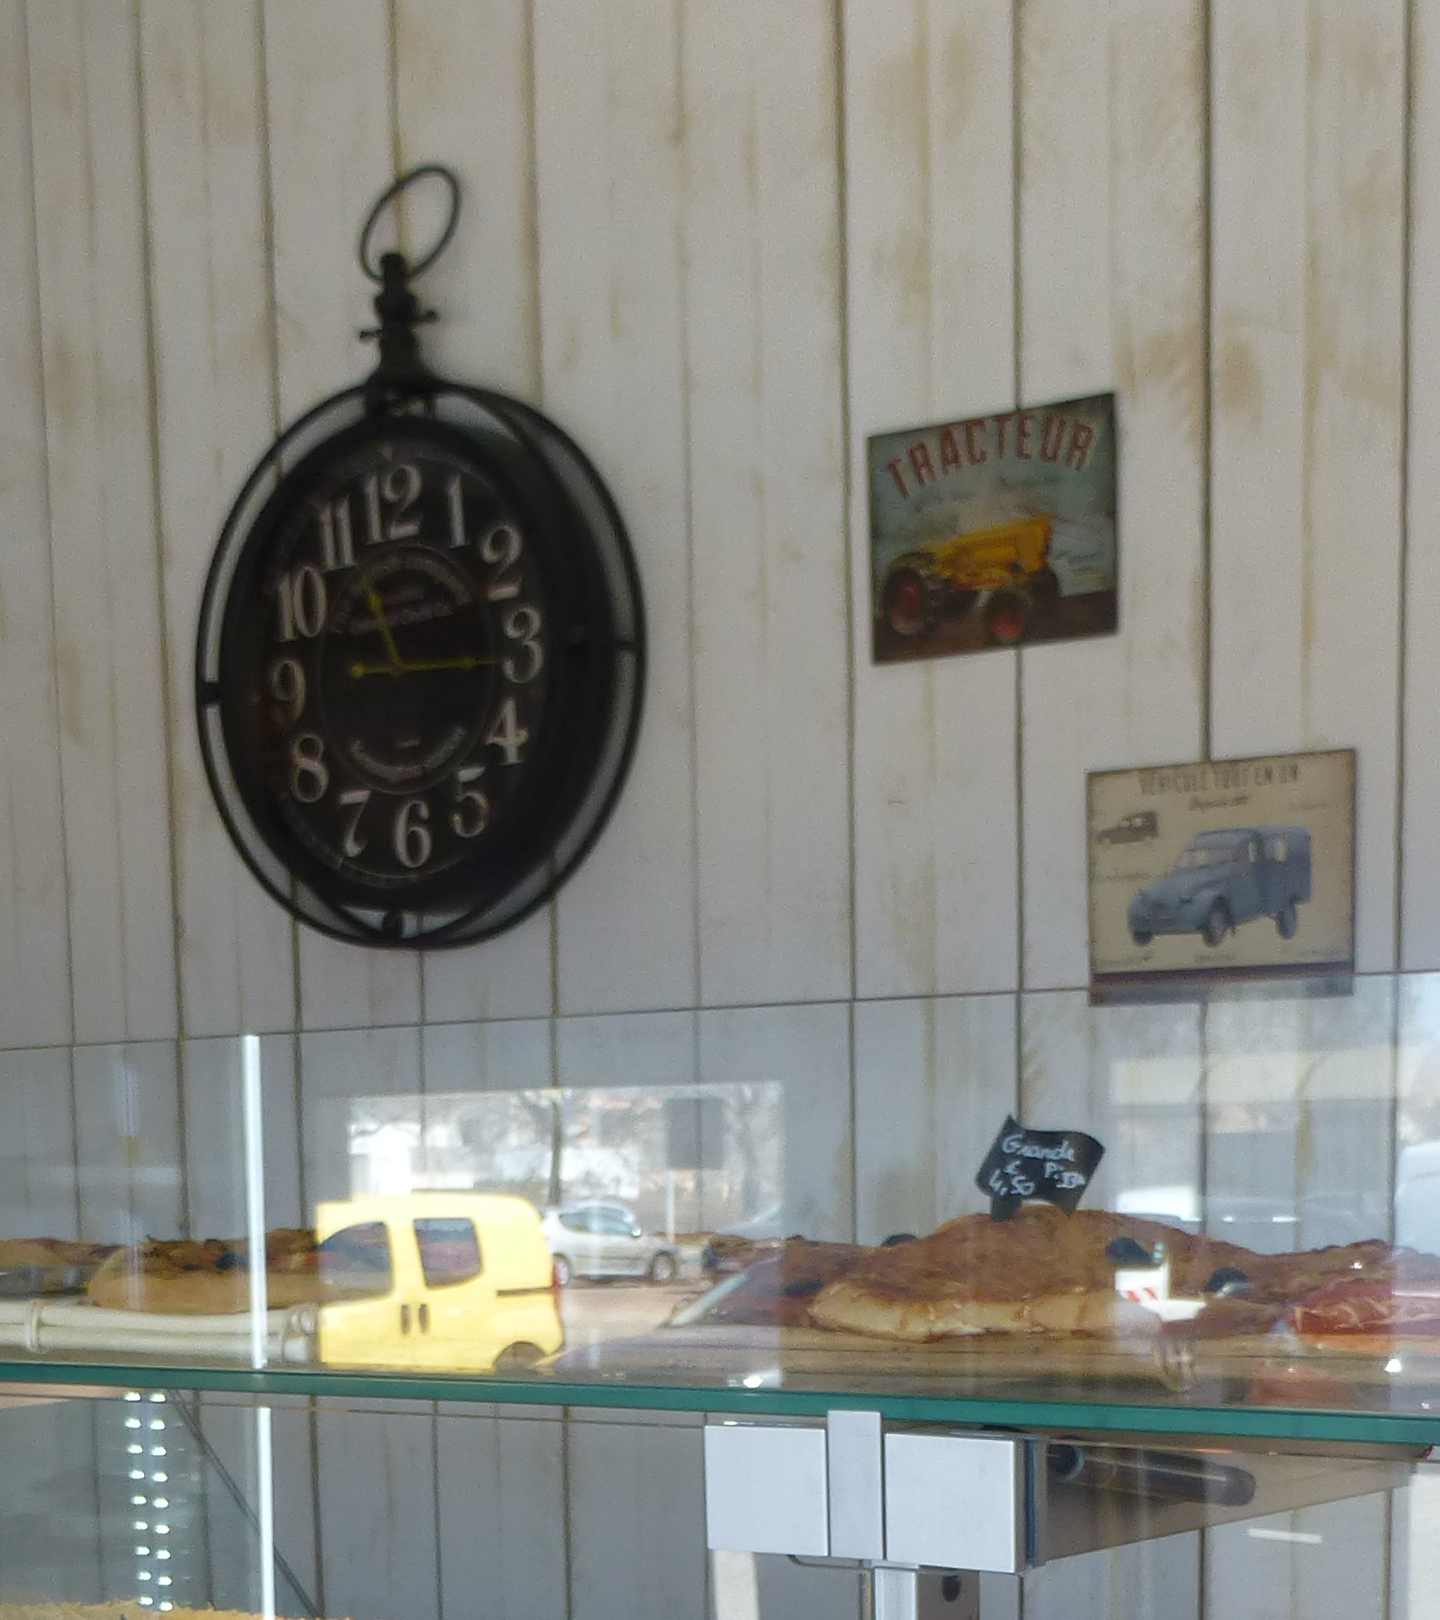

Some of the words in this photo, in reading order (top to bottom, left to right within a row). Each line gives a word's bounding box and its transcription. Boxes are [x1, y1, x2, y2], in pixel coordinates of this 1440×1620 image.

[886, 411, 1095, 499] TRACTEUR
[318, 498, 357, 573] 11
[363, 464, 422, 544] 12
[446, 474, 472, 548] 1
[480, 524, 524, 600] 2
[273, 565, 328, 642] 10
[501, 605, 544, 684] 3
[269, 659, 307, 725] 9
[291, 733, 329, 803] 8
[486, 697, 529, 766] 4
[339, 789, 372, 858] 7
[394, 800, 433, 869] 6
[452, 765, 489, 838] 5
[988, 1168, 1036, 1197] 4,50
[1001, 1133, 1076, 1163] Grande
